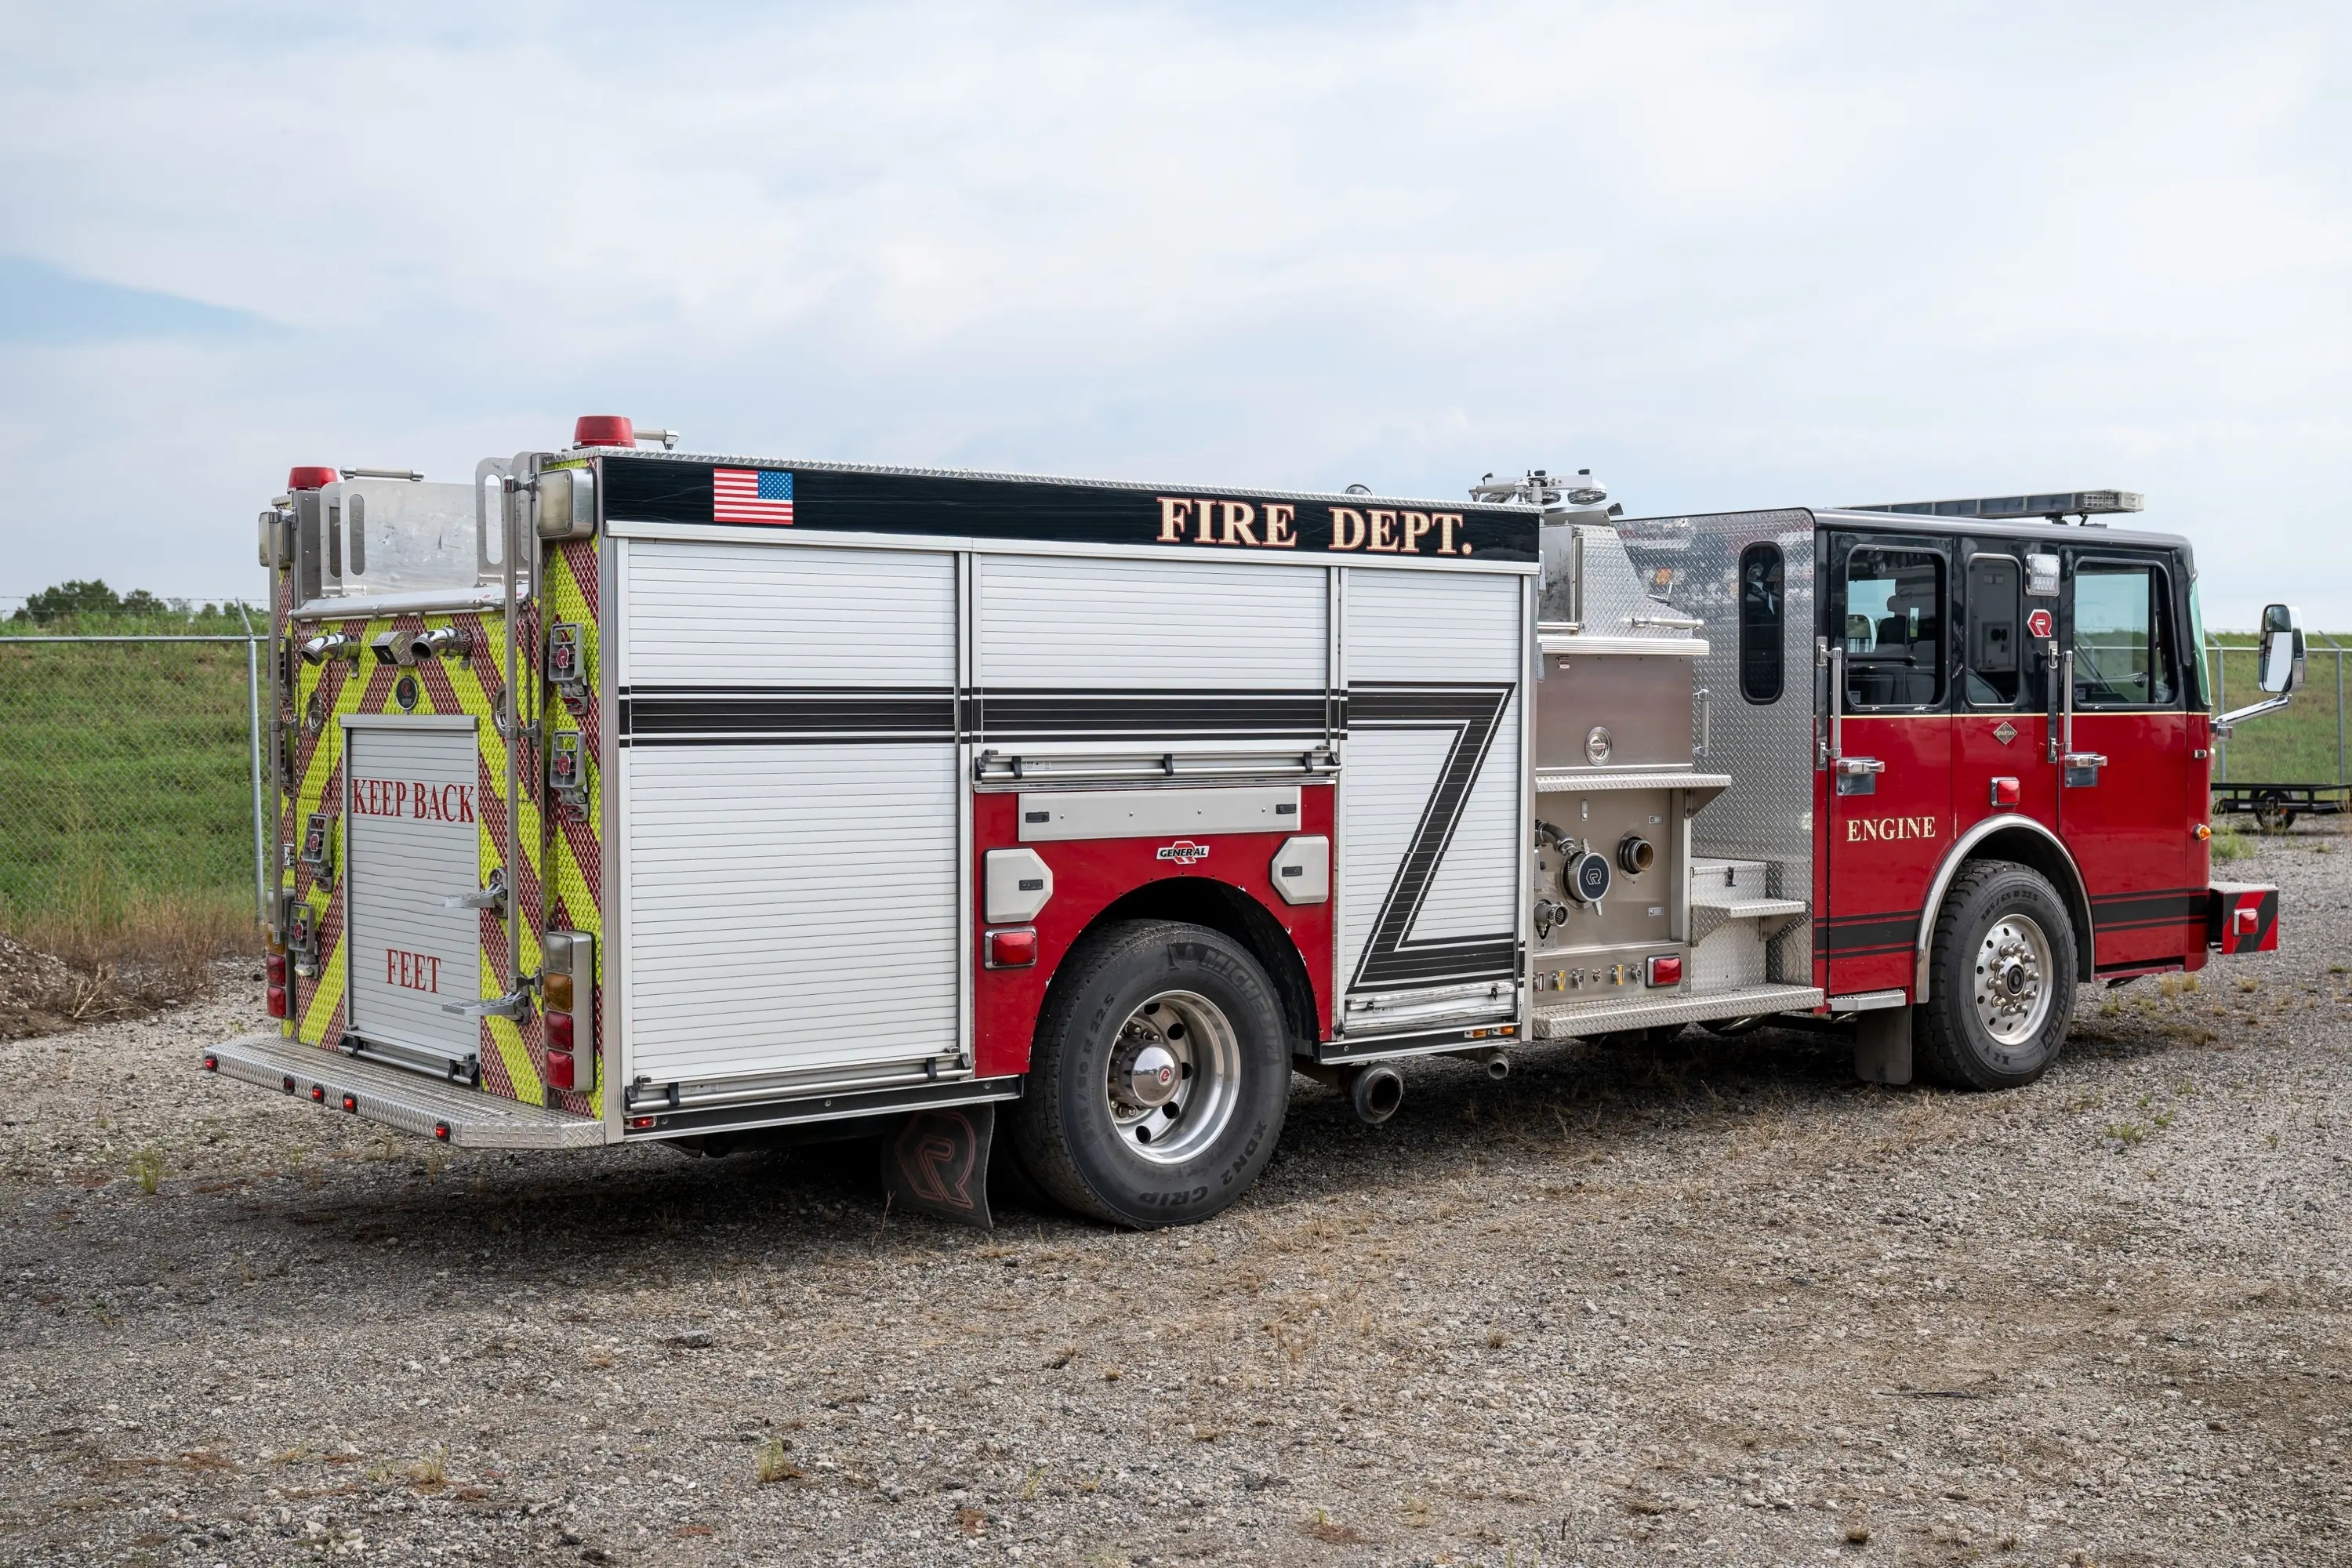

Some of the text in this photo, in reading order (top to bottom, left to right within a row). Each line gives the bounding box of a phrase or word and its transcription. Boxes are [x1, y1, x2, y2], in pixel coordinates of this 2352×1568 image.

[1156, 496, 1473, 556] FIRE DEPT.
[352, 779, 474, 823] KEEP BACK
[1846, 816, 1936, 842] ENGINE
[1160, 847, 1207, 858] GENERAL
[386, 948, 441, 994] FEET
[1090, 993, 1116, 1034] 22.5
[1200, 949, 1282, 1061] MICHELIN
[2043, 962, 2069, 1048] MICHELIN
[1138, 1185, 1209, 1207] GRIP
